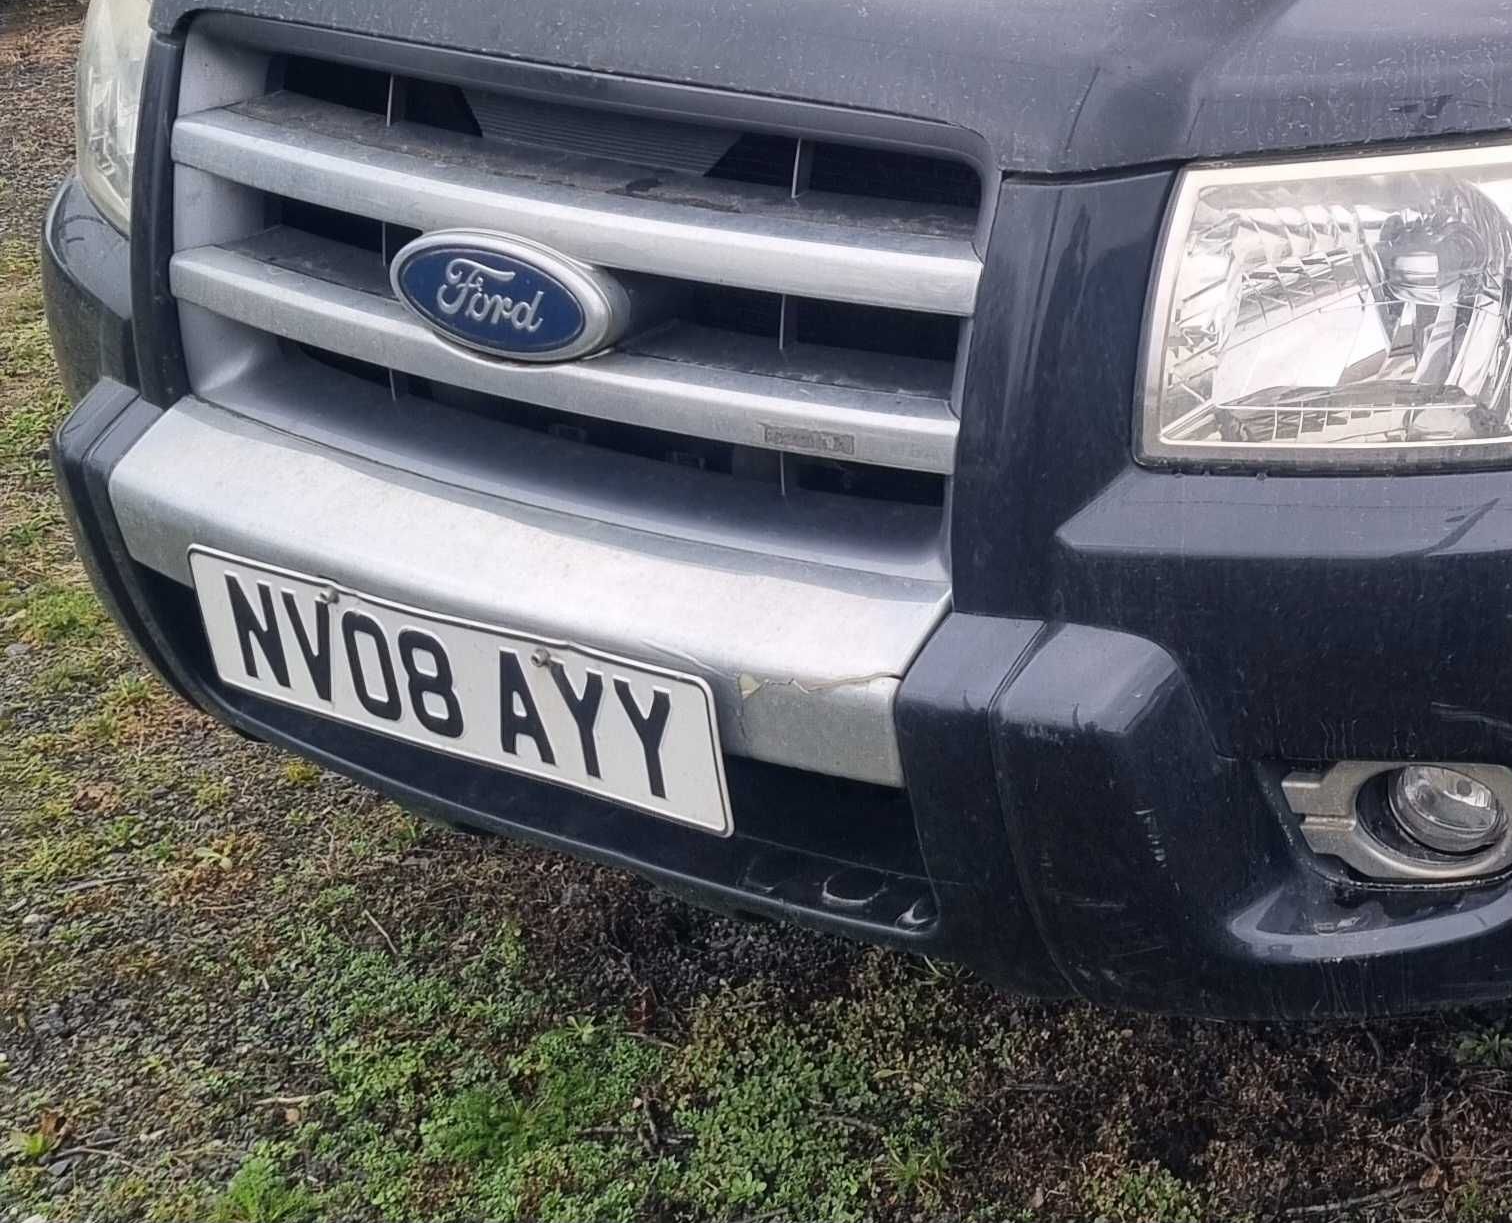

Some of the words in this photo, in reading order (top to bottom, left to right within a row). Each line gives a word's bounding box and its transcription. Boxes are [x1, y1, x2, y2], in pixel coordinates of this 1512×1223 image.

[436, 257, 545, 333] Ford
[223, 573, 464, 739] NV08
[499, 649, 672, 800] AYY
